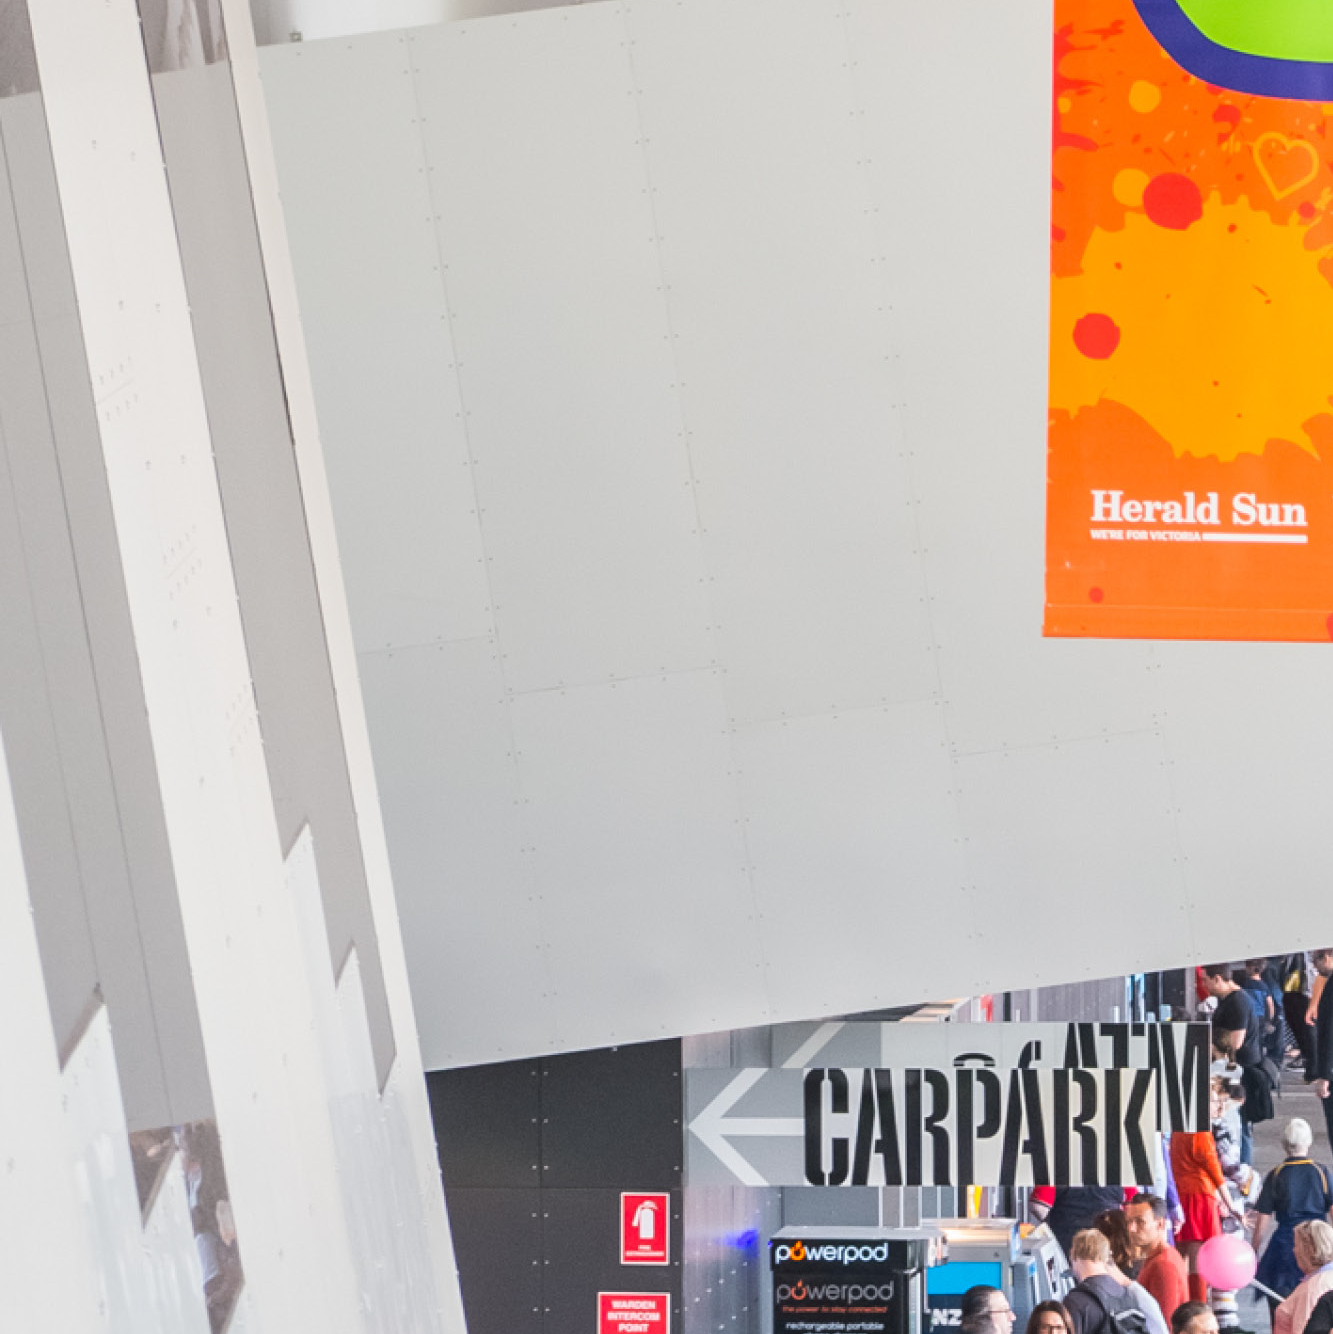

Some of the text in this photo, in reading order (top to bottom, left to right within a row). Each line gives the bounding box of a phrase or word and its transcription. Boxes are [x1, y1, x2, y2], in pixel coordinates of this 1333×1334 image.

[1090, 489, 1309, 527] Herald Sun
[1126, 530, 1149, 540] FOR
[1150, 530, 1200, 541] VICTORIA
[804, 1067, 1154, 1187] CARPARK
[775, 1241, 889, 1265] powerpod
[776, 1280, 895, 1304] powerpod
[611, 1300, 656, 1310] WARDEN
[607, 1311, 661, 1321] INTERCOM
[932, 1309, 962, 1326] NZ
[618, 1323, 650, 1333] POINT
[846, 1322, 885, 1331] portable
